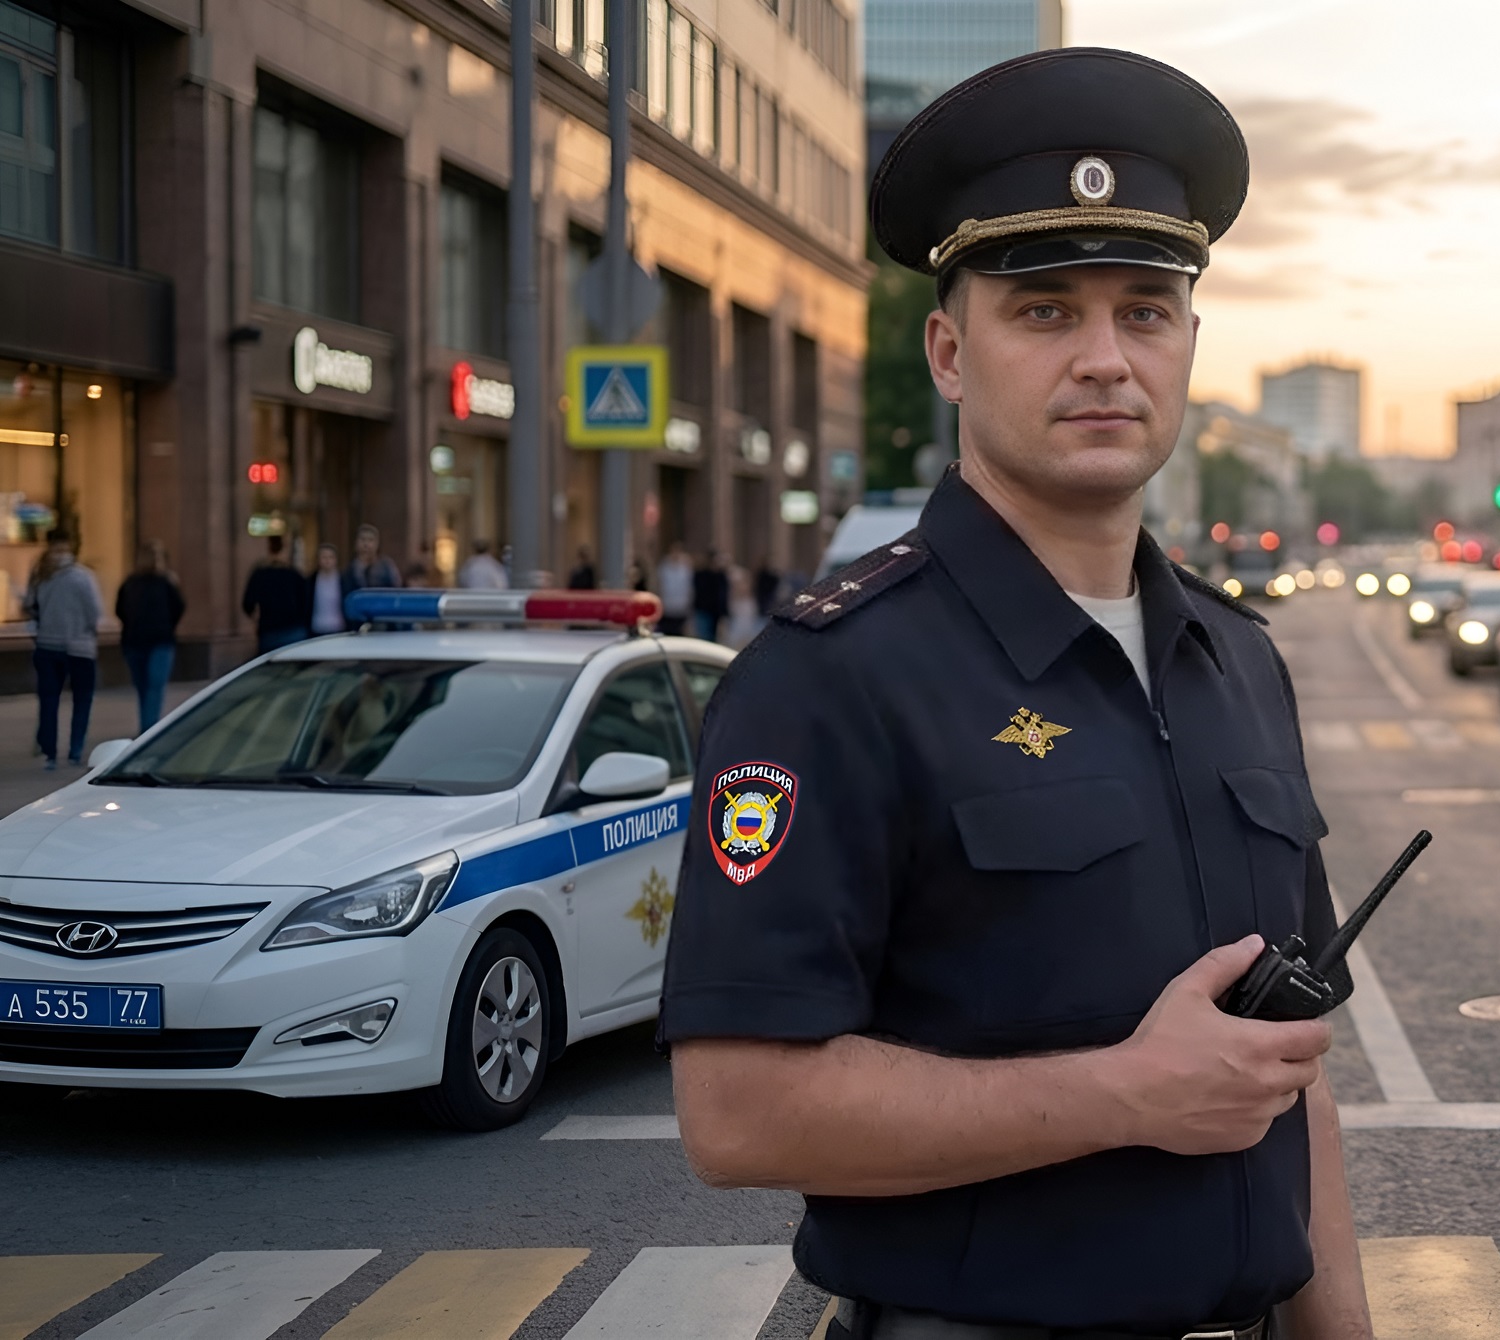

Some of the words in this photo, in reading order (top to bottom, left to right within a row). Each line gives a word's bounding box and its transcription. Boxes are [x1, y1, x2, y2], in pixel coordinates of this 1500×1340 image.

[717, 765, 793, 793] ПОЛИЦИЯ
[603, 803, 678, 852] ПОЛИЦИЯ
[726, 861, 756, 882] МВД
[35, 988, 88, 1020] 535
[117, 989, 148, 1018] 77
